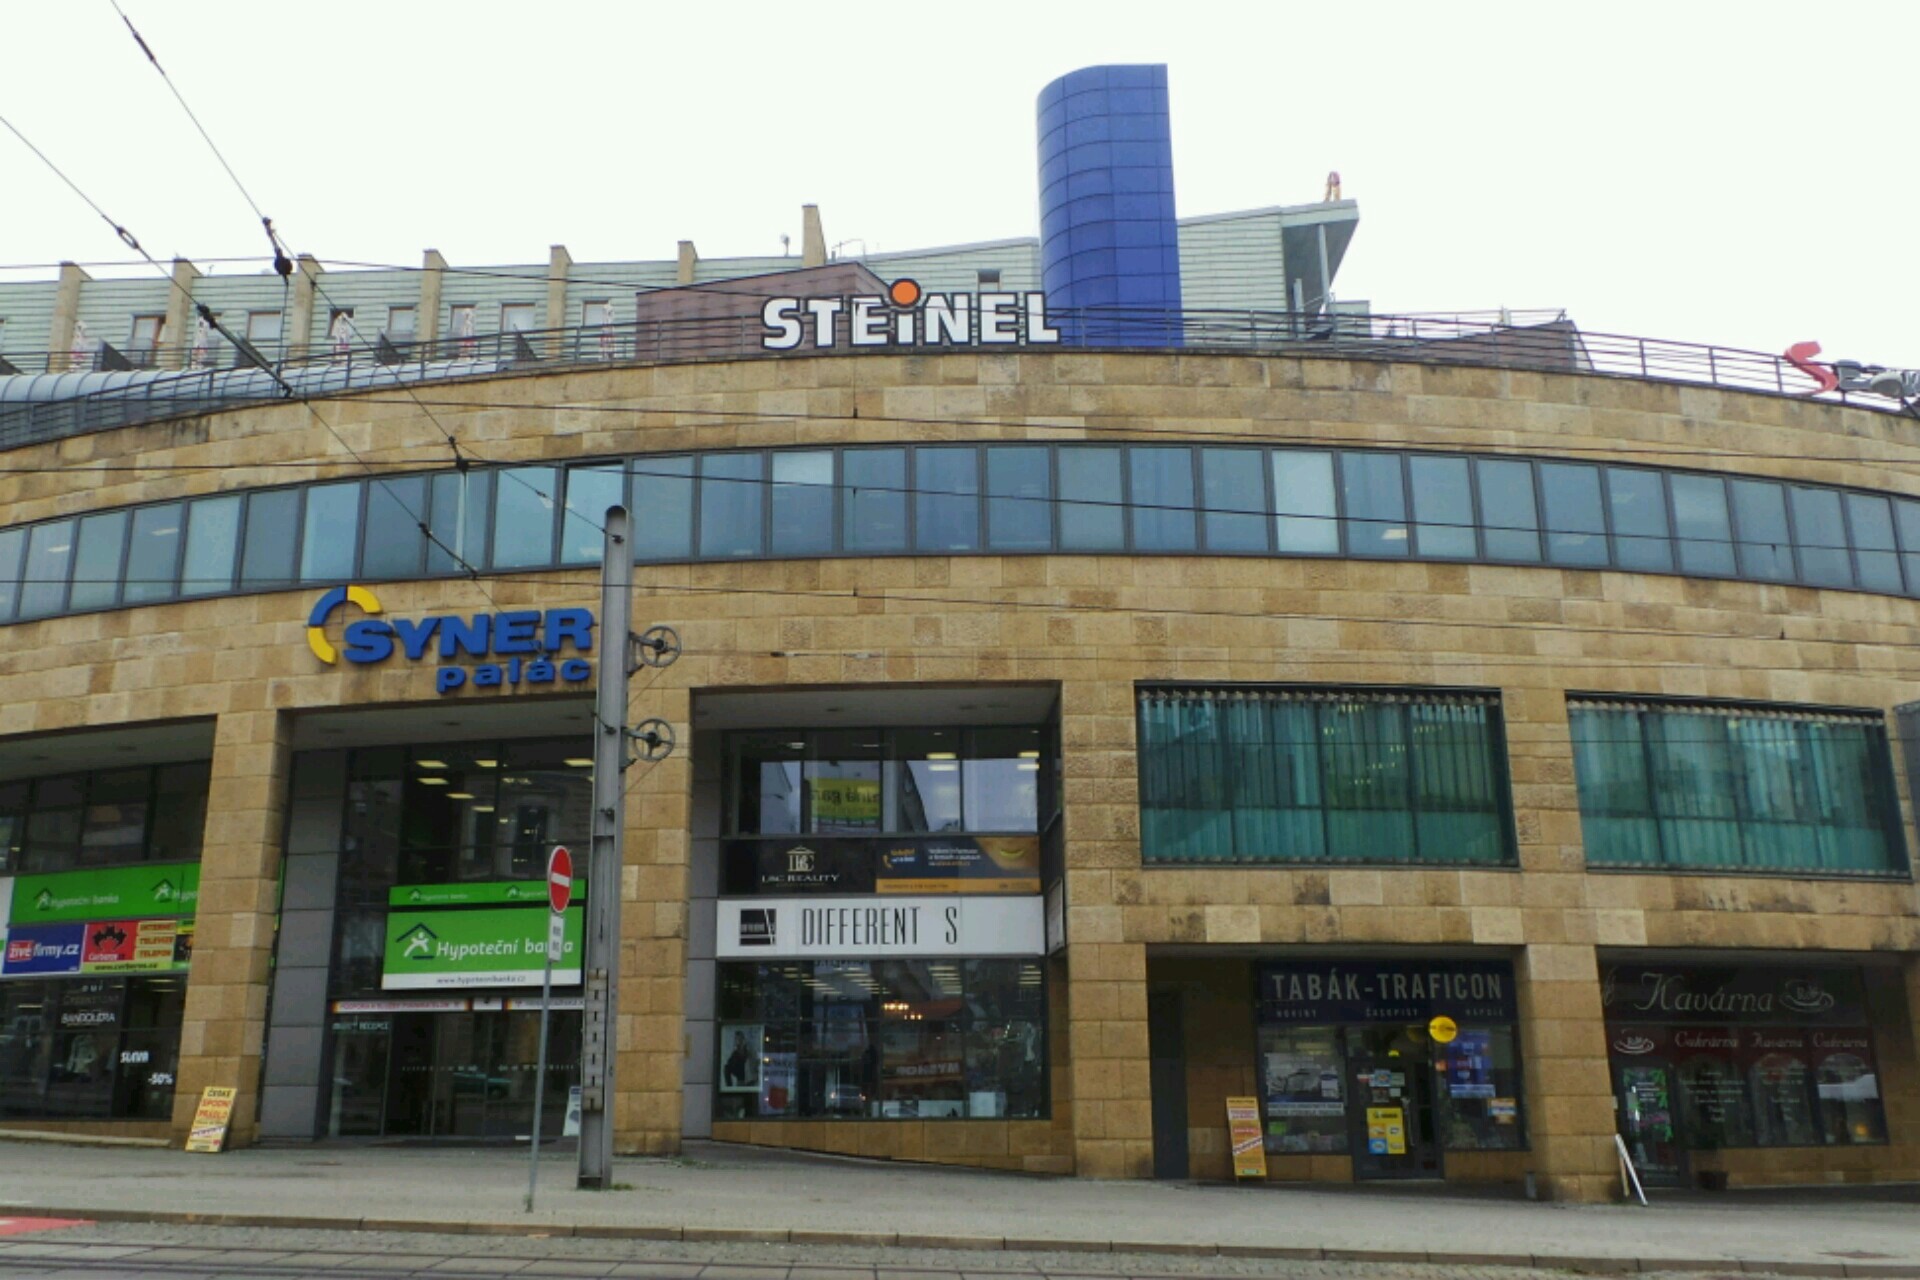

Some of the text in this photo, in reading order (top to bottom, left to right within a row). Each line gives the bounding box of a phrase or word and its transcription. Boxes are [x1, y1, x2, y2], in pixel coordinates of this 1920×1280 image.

[342, 607, 594, 664] SYNER
[435, 654, 592, 694] palác
[787, 874, 840, 882] REALITY
[801, 906, 958, 945] DIFFERENT S
[436, 939, 519, 960] Hypoteční
[525, 937, 574, 954] baa
[1634, 971, 1774, 1012] Kavárna
[1276, 1009, 1317, 1018] NOVINY
[1674, 1031, 1740, 1049] Cukrárna
